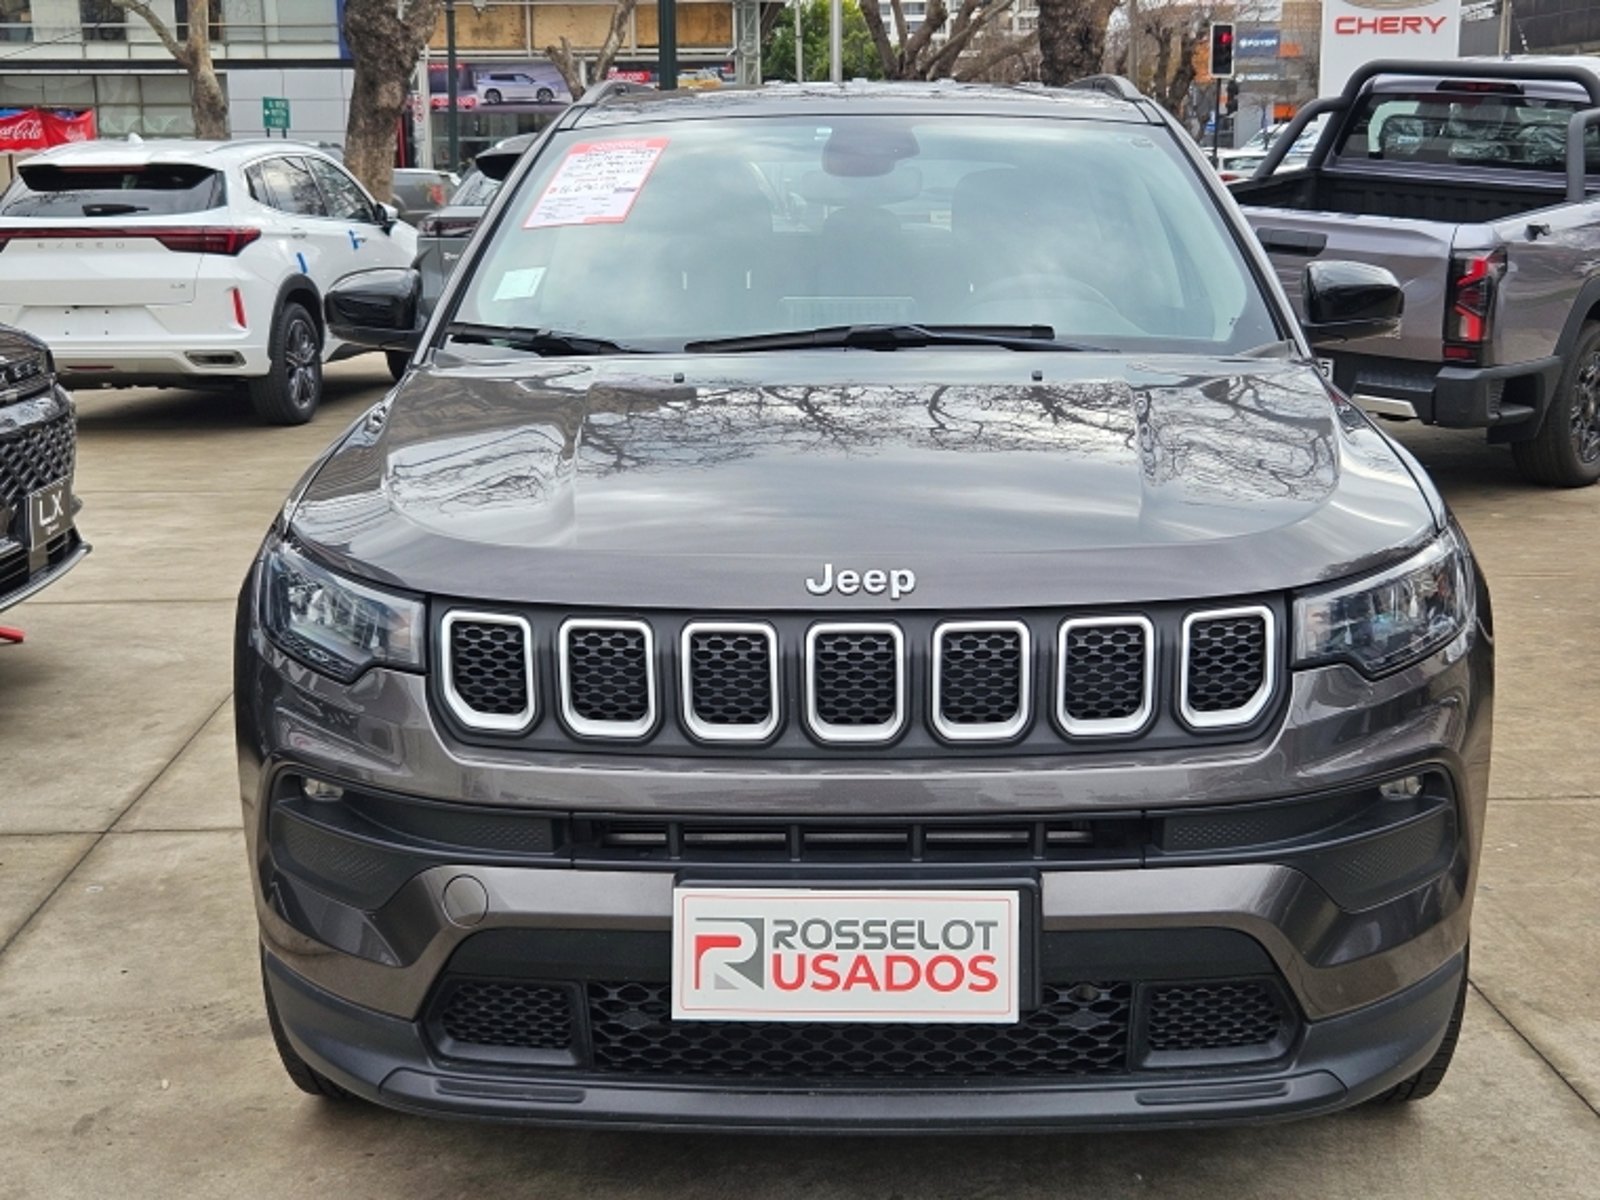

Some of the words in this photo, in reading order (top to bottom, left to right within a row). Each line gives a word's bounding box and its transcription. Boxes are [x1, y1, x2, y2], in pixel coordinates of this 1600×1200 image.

[1334, 16, 1447, 35] CHERY
[39, 490, 64, 527] LX
[804, 563, 916, 600] Jeep
[772, 918, 999, 950] ROSSELOT
[772, 953, 999, 993] USADOS
